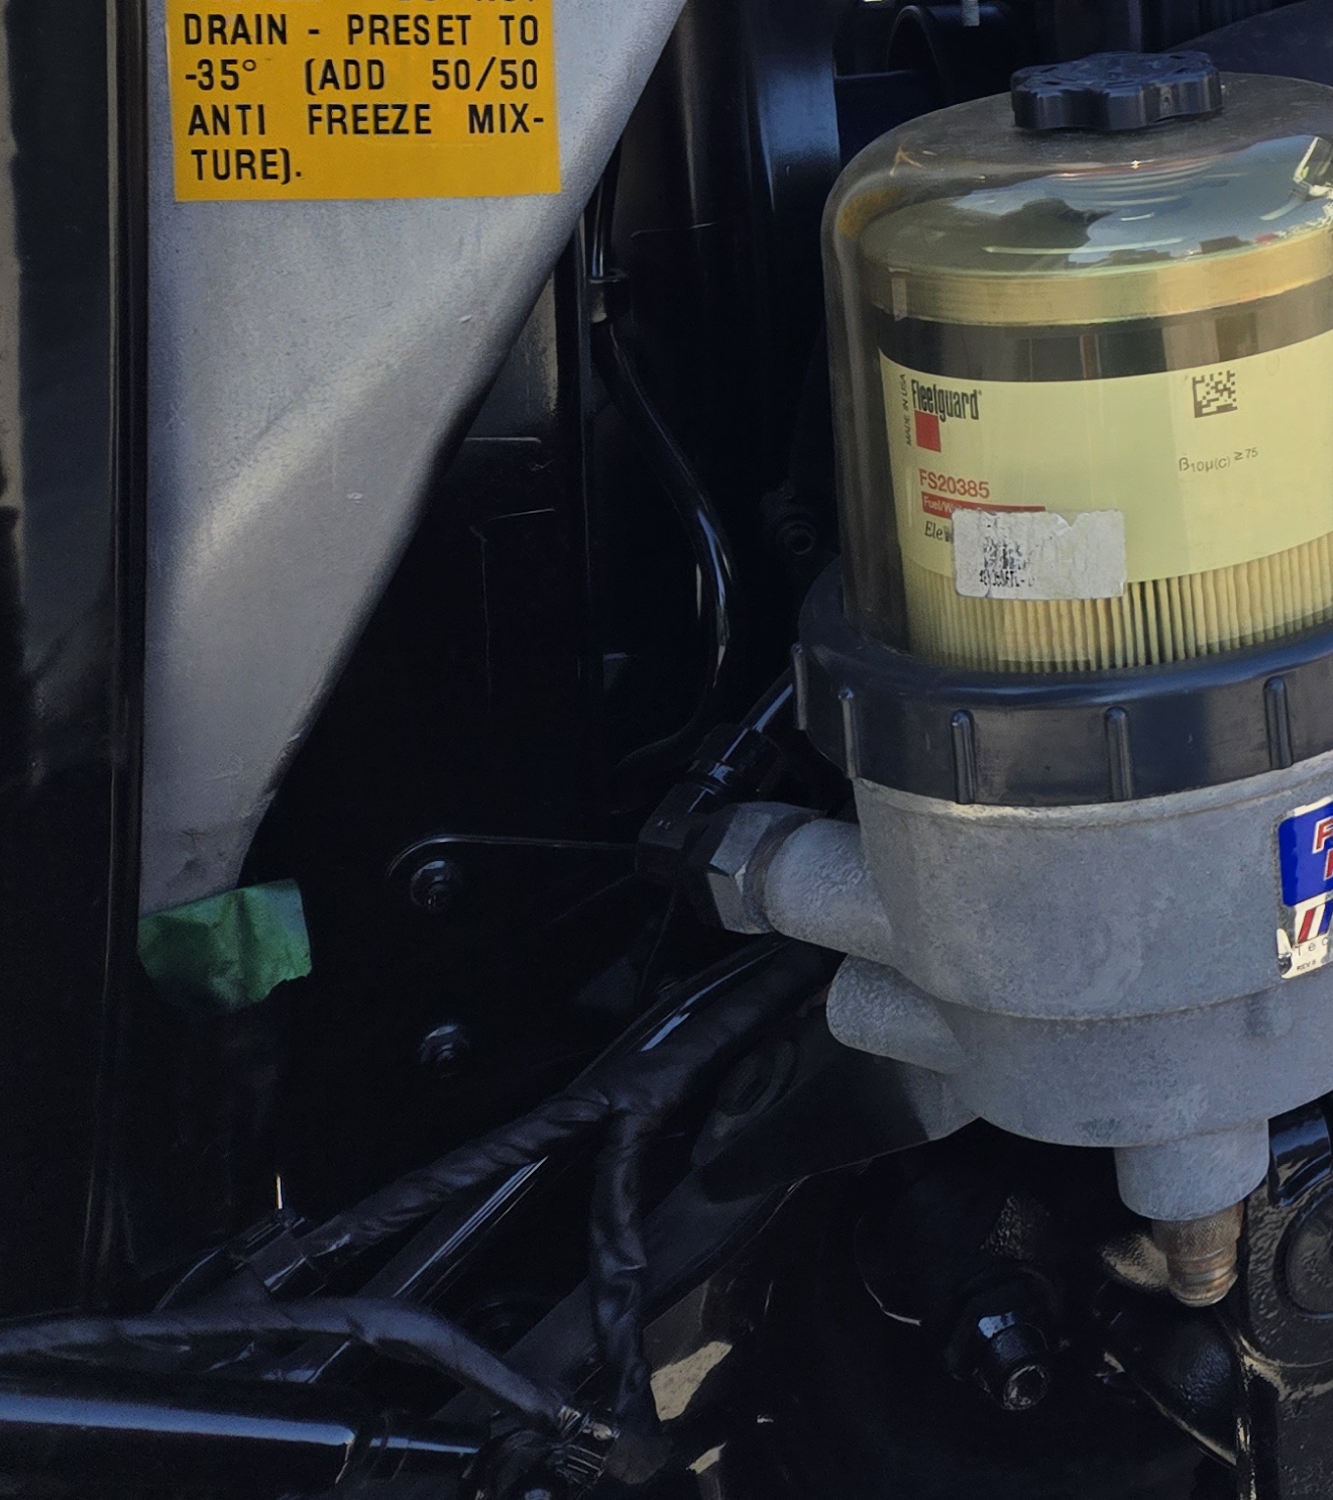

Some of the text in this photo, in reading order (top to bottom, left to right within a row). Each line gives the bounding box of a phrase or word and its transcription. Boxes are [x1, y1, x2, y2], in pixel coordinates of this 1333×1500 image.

[184, 13, 288, 45] DRAIN
[347, 14, 472, 45] PRESET
[502, 15, 539, 45] TO
[185, 56, 539, 93] -35° (ADD 50/50
[188, 104, 544, 136] ANTI FREEZE MIX-
[191, 148, 302, 184] TURE).
[911, 379, 980, 422] Fleetguard
[918, 468, 991, 499] FS20385
